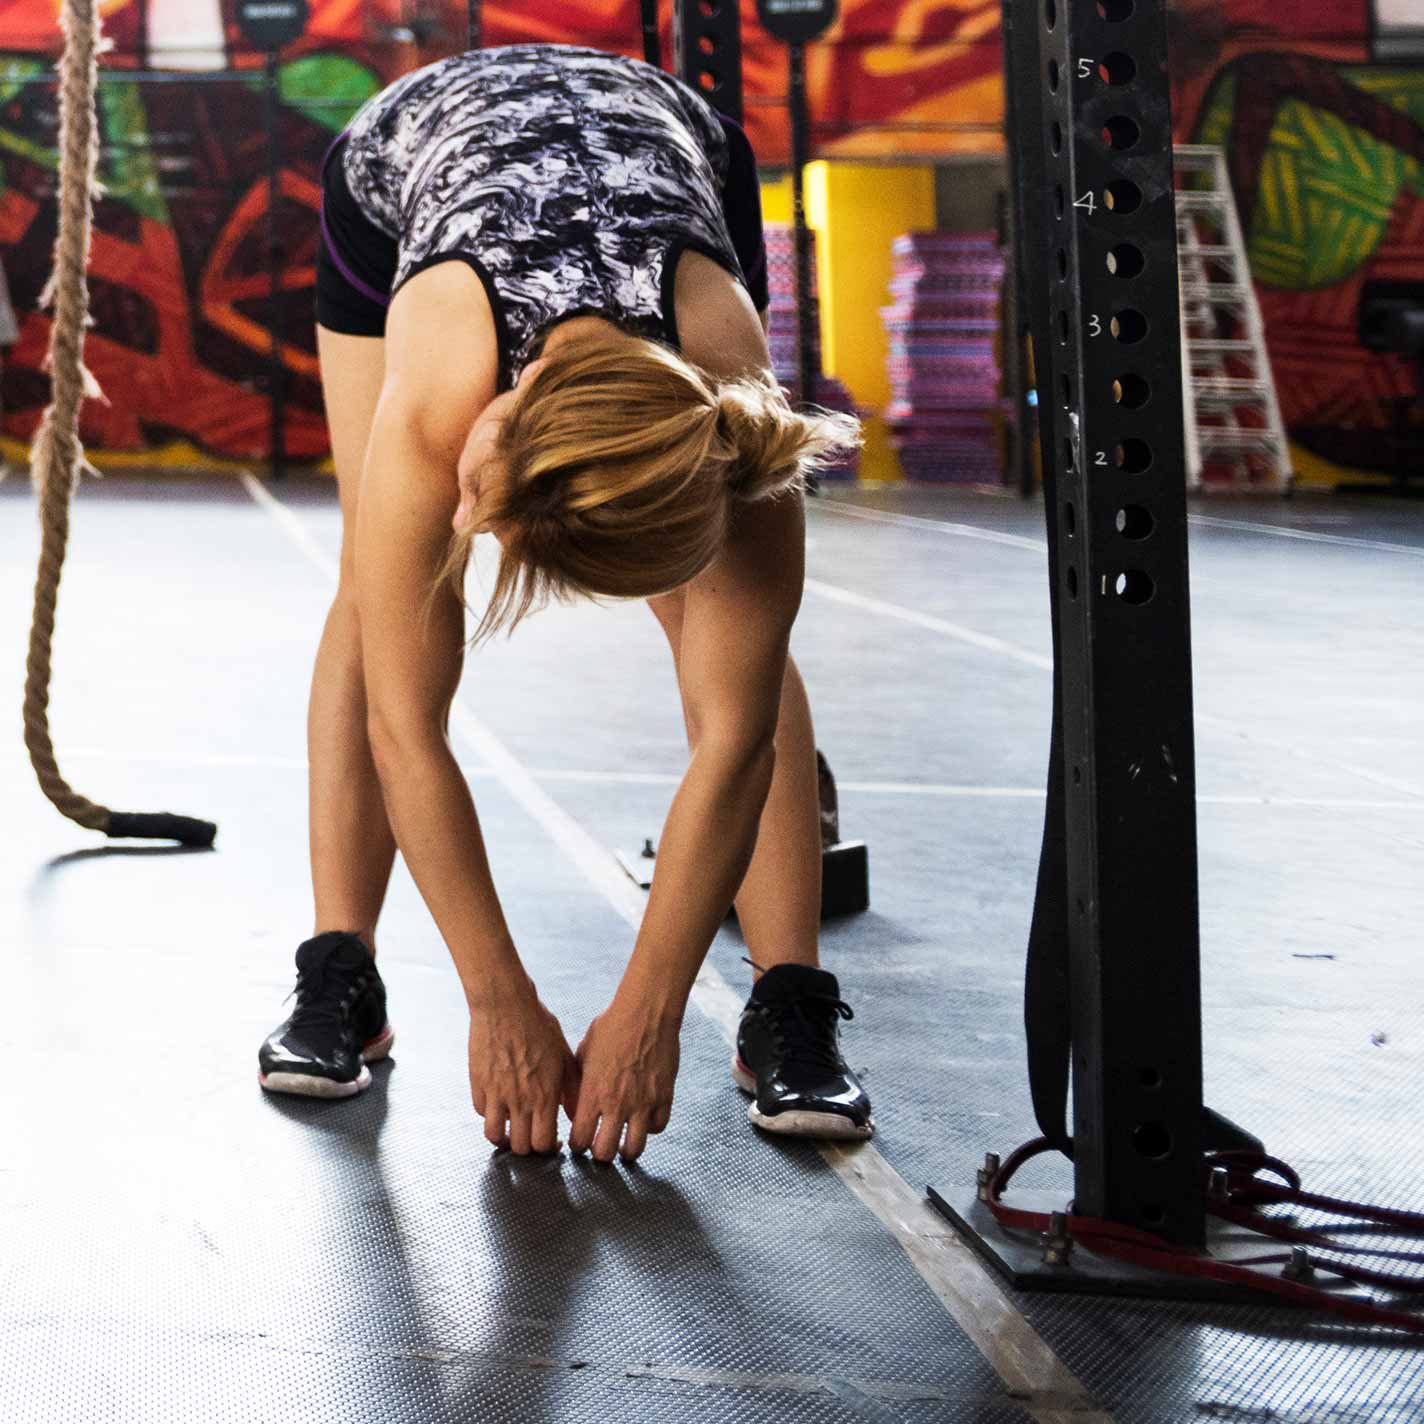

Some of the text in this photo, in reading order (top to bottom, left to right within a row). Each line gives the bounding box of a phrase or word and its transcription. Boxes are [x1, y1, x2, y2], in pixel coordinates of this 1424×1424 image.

[1077, 59, 1094, 78] 5
[1073, 191, 1096, 215] 4
[1089, 315, 1102, 337] 3
[1095, 451, 1108, 466] 2
